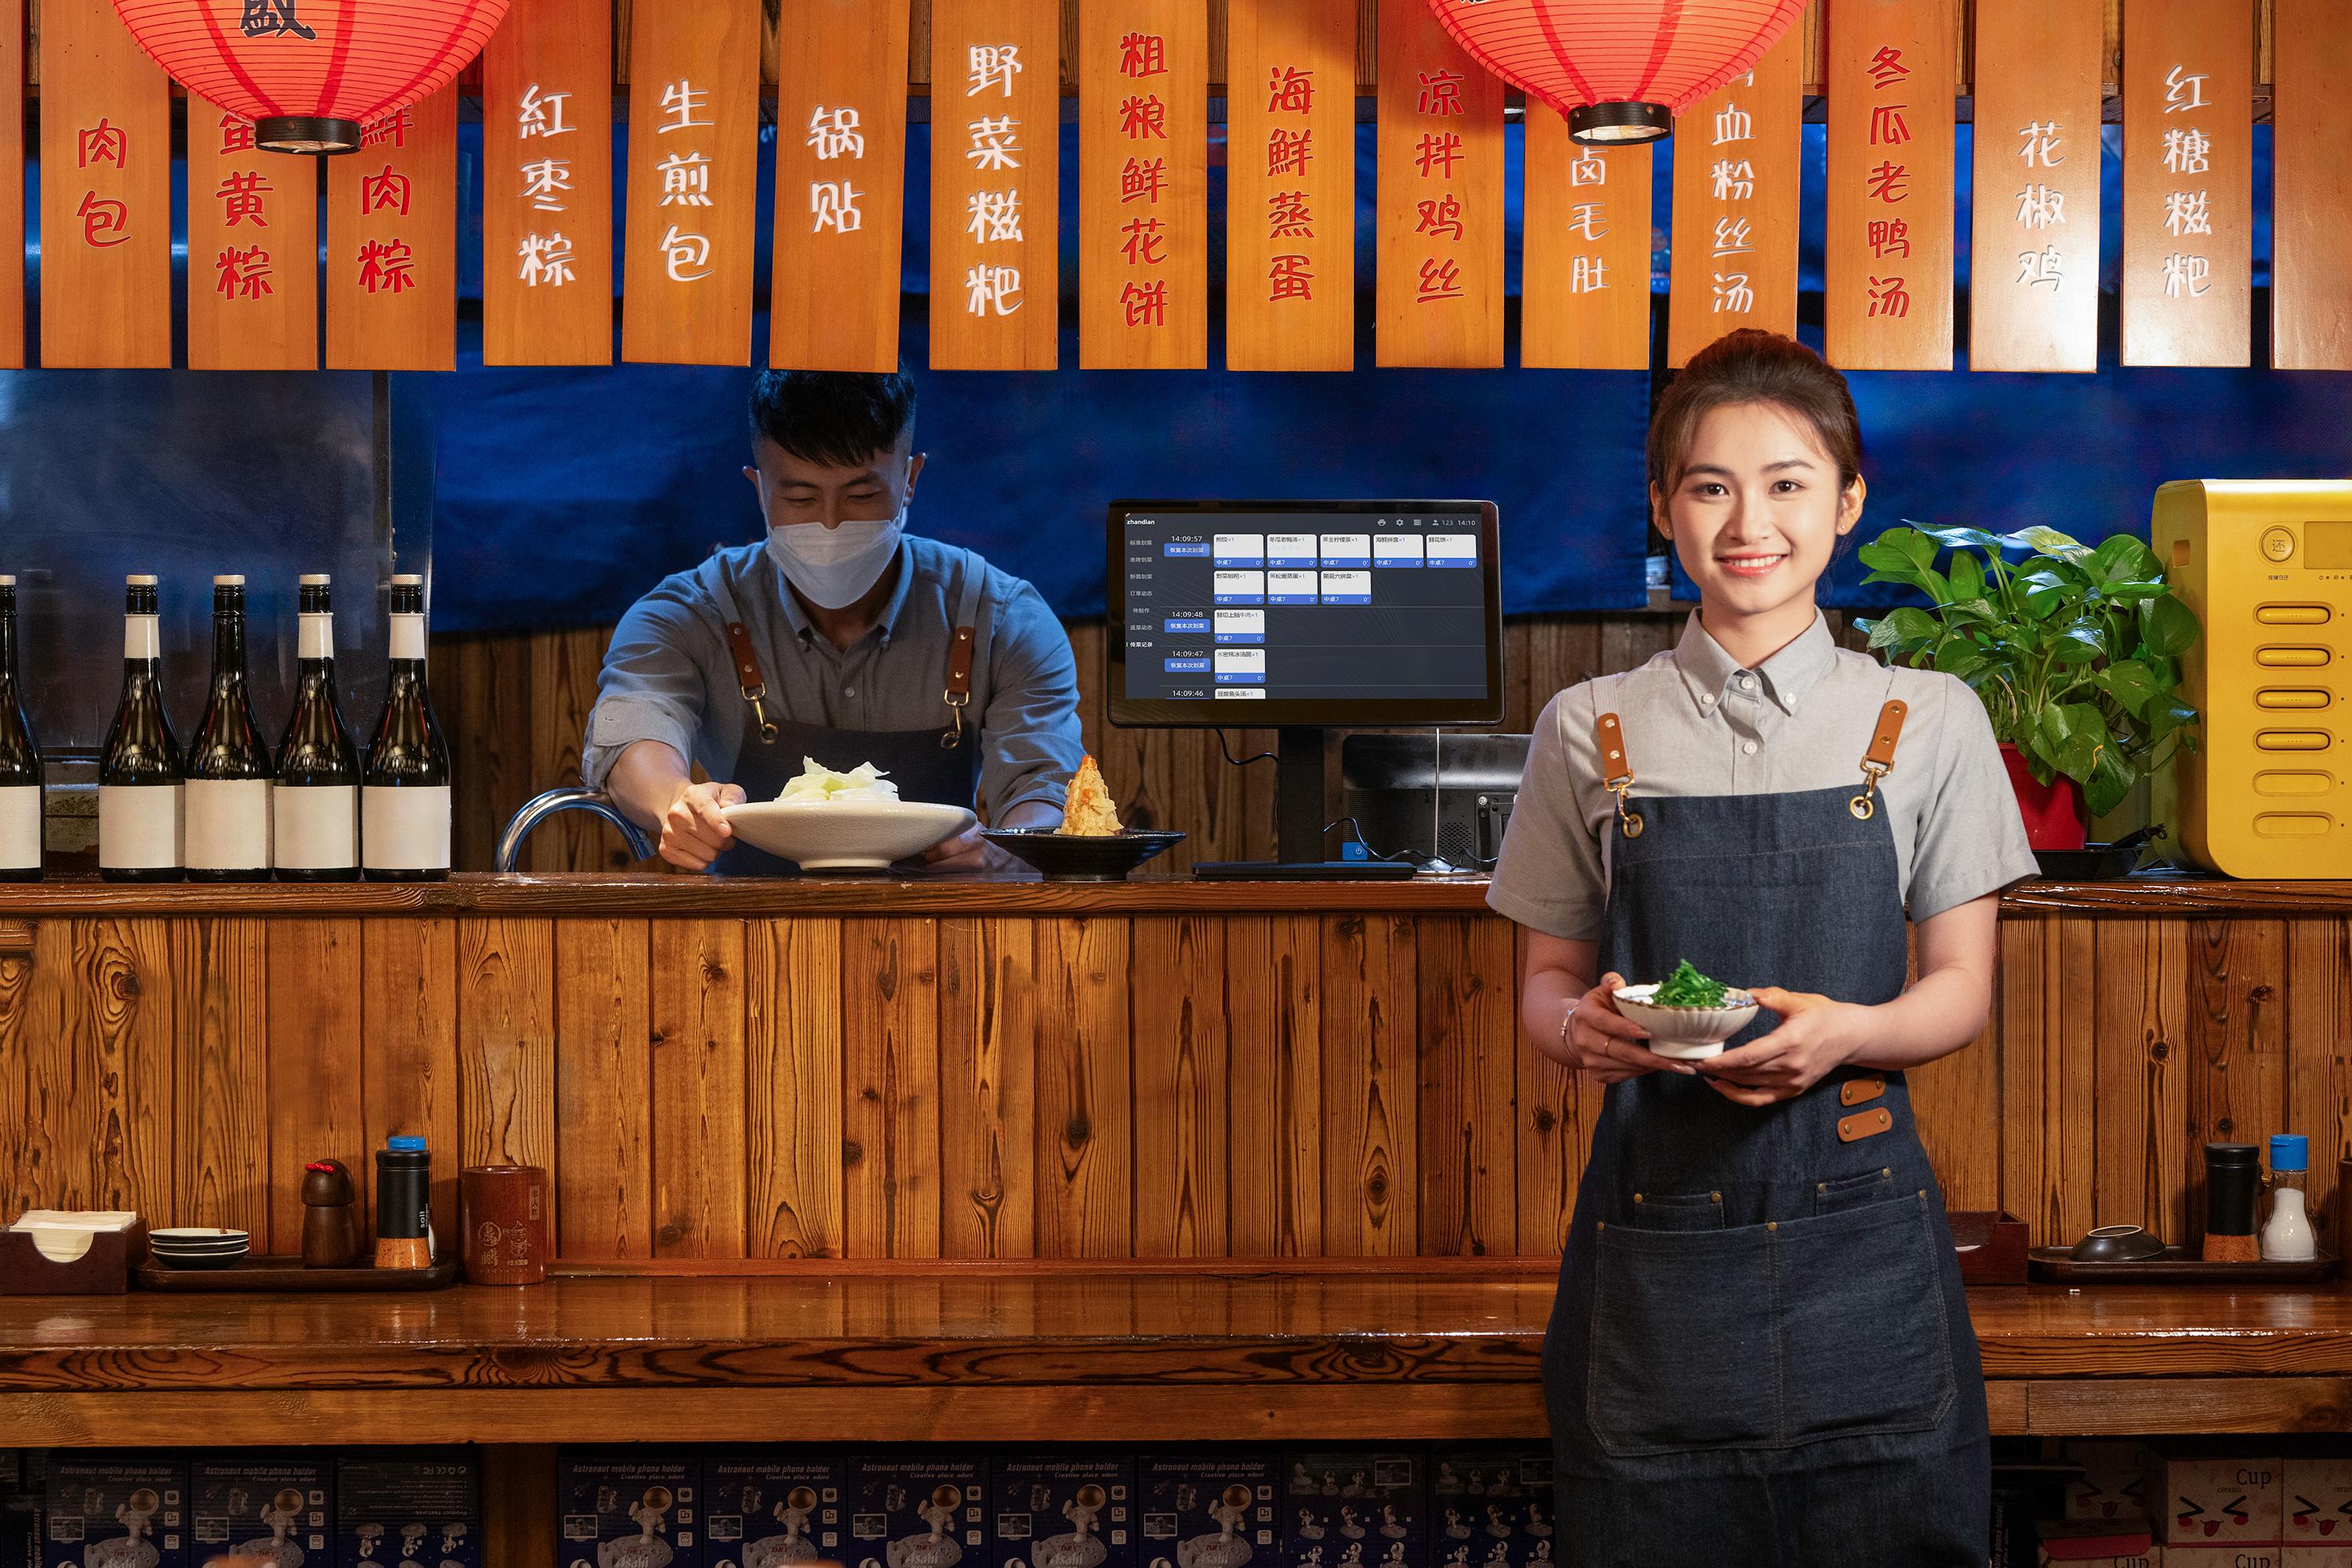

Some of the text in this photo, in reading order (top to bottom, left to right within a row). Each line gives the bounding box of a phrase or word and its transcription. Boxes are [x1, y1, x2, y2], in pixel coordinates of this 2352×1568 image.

[78, 118, 132, 249] 肉包
[655, 78, 714, 282] 生煎包
[806, 103, 865, 234] 锅贴
[964, 44, 1023, 318] 野菜糍粑
[1120, 31, 1169, 327] 粗粮鲜花饼
[1414, 68, 1465, 304] 凉拌鸡丝
[1710, 67, 1756, 314] 血粉丝汤
[1866, 45, 1913, 318] 冬瓜老鸭汤
[2016, 120, 2067, 292] 花椒鸡
[2161, 64, 2213, 299] 红糖糍粑
[2272, 539, 2285, 552] 还
[637, 1465, 660, 1474] phone
[717, 1465, 830, 1475] Astronaut mobile phone holder
[862, 1463, 975, 1473] Astronaut mobile phone holder
[2217, 1485, 2244, 1494] ceramic
[2236, 1468, 2271, 1488] Cup
[905, 1552, 938, 1565] Asahi
[1049, 1553, 1083, 1565] Asahi
[2235, 1554, 2270, 1568] Cup
